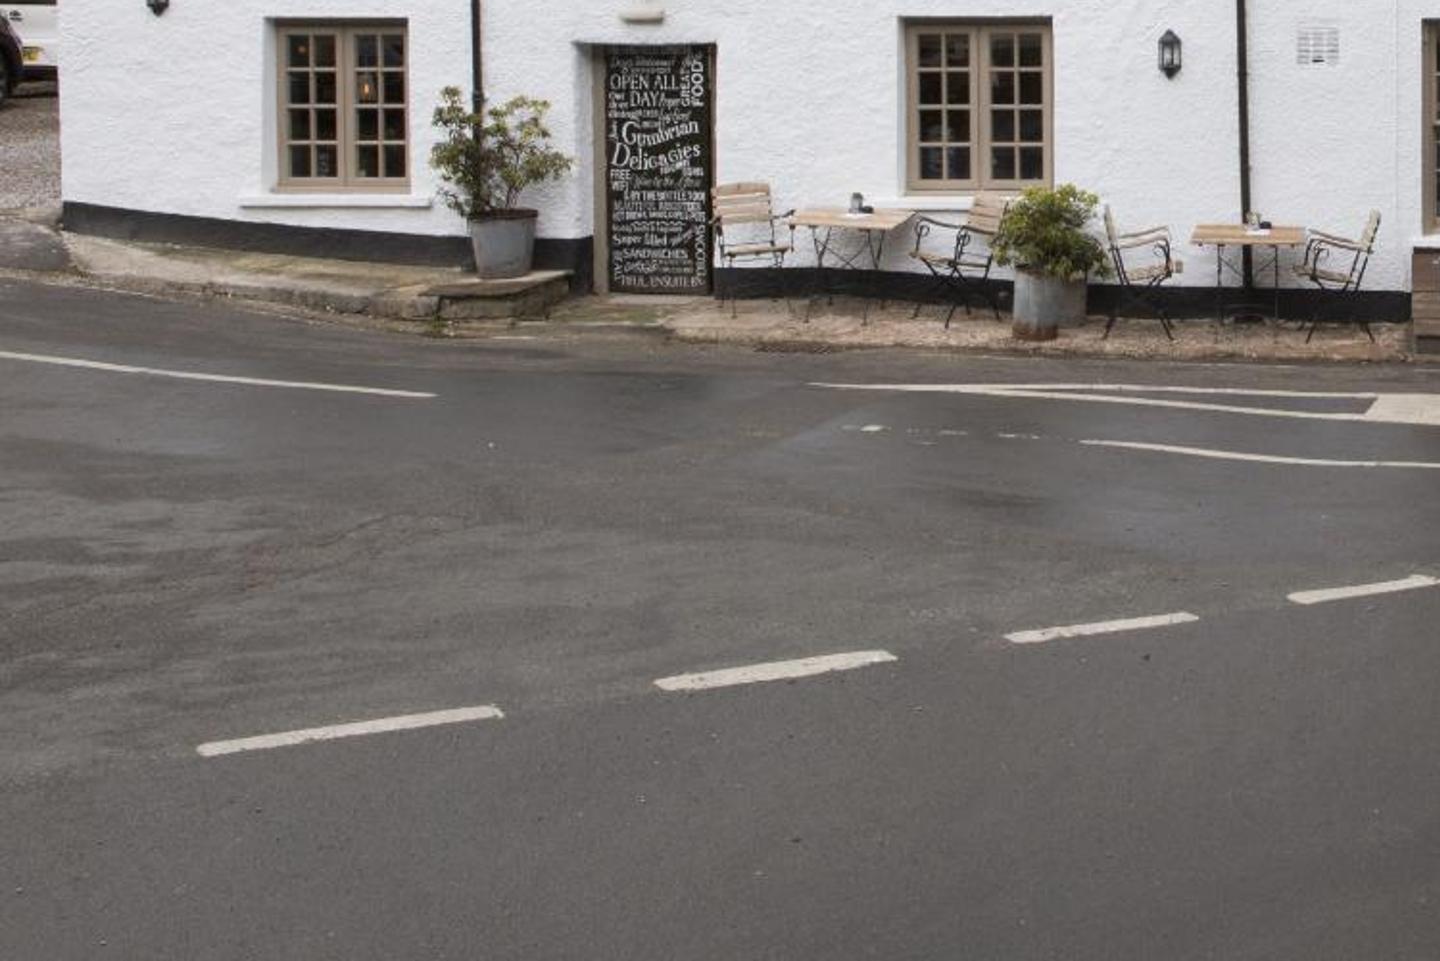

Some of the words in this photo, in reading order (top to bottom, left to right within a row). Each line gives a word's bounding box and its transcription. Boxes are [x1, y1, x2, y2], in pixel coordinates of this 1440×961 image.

[610, 73, 649, 90] OPEN
[653, 74, 680, 90] ALL
[690, 61, 705, 108] FOOD
[630, 90, 659, 107] DAY
[622, 121, 700, 147] Cumbrian
[610, 169, 632, 181] FREE
